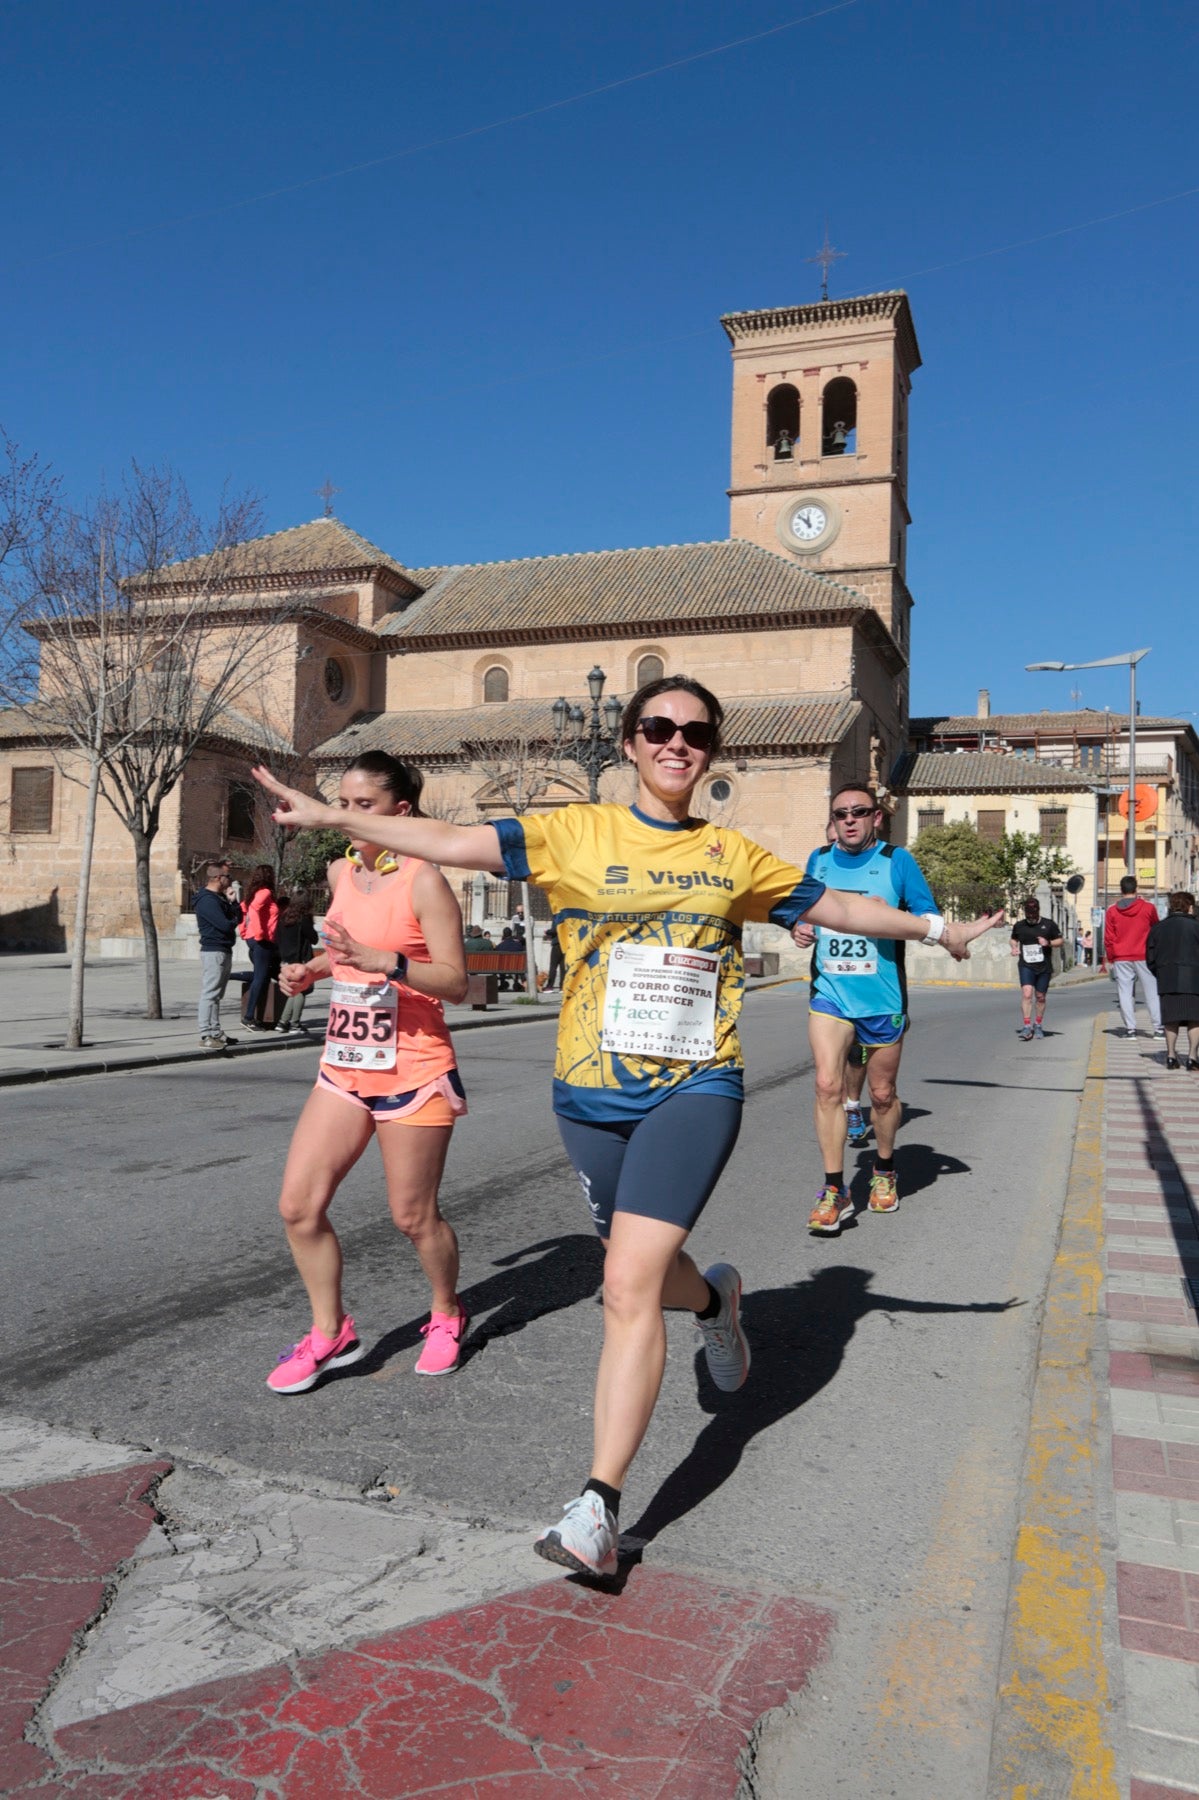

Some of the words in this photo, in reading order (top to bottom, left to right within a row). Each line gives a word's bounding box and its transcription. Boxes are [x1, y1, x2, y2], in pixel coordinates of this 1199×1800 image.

[647, 869, 735, 892] Vigilsa
[597, 888, 636, 896] SEAT
[672, 913, 693, 923] LOS
[829, 939, 867, 958] 823
[668, 954, 710, 971] Cruzcampo
[611, 979, 626, 988] YO
[629, 981, 670, 991] CORRO
[673, 984, 712, 999] CONTRA
[633, 993, 647, 1002] EL
[650, 994, 694, 1007] CANCER
[627, 1007, 670, 1021] aecc
[328, 1008, 392, 1043] 2255
